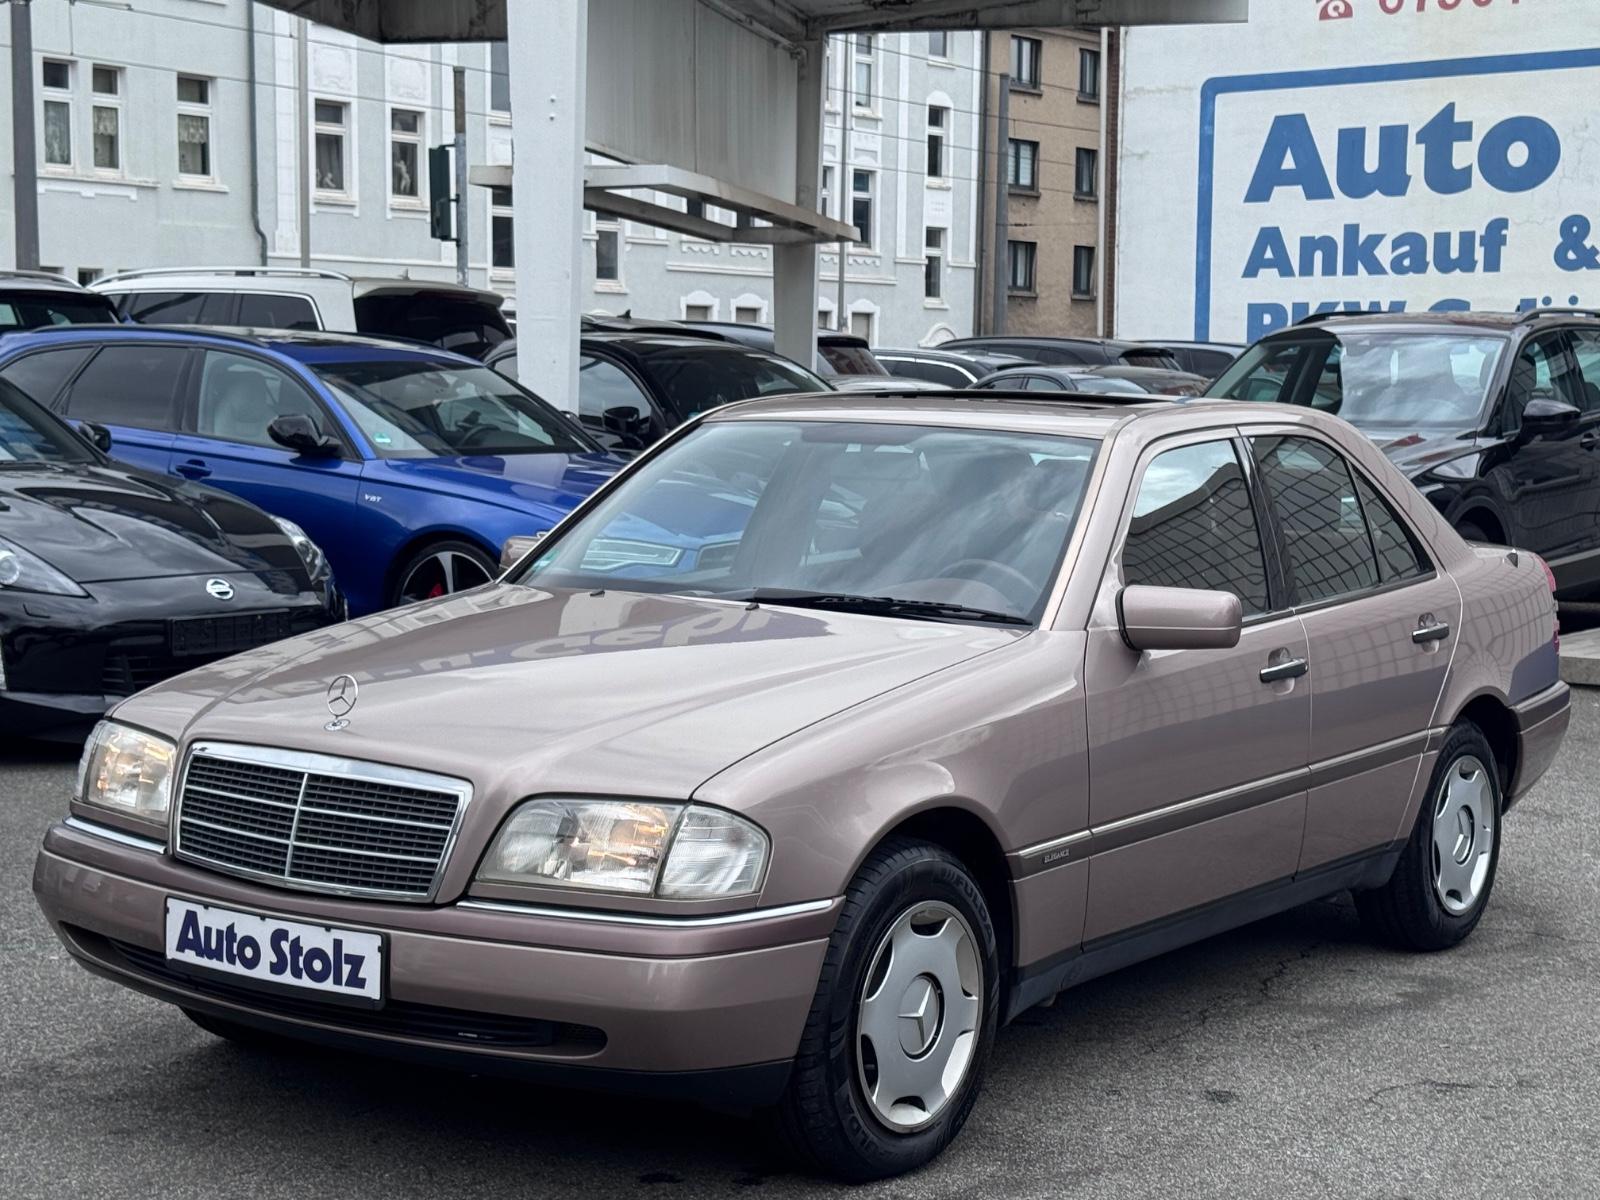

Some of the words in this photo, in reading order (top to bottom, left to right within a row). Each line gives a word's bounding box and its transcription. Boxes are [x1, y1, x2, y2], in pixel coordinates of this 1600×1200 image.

[1244, 102, 1561, 203] Auto
[1242, 218, 1509, 278] Ankauf
[1554, 214, 1600, 272] &
[176, 909, 262, 971] Auto
[269, 928, 367, 990] Stolz
